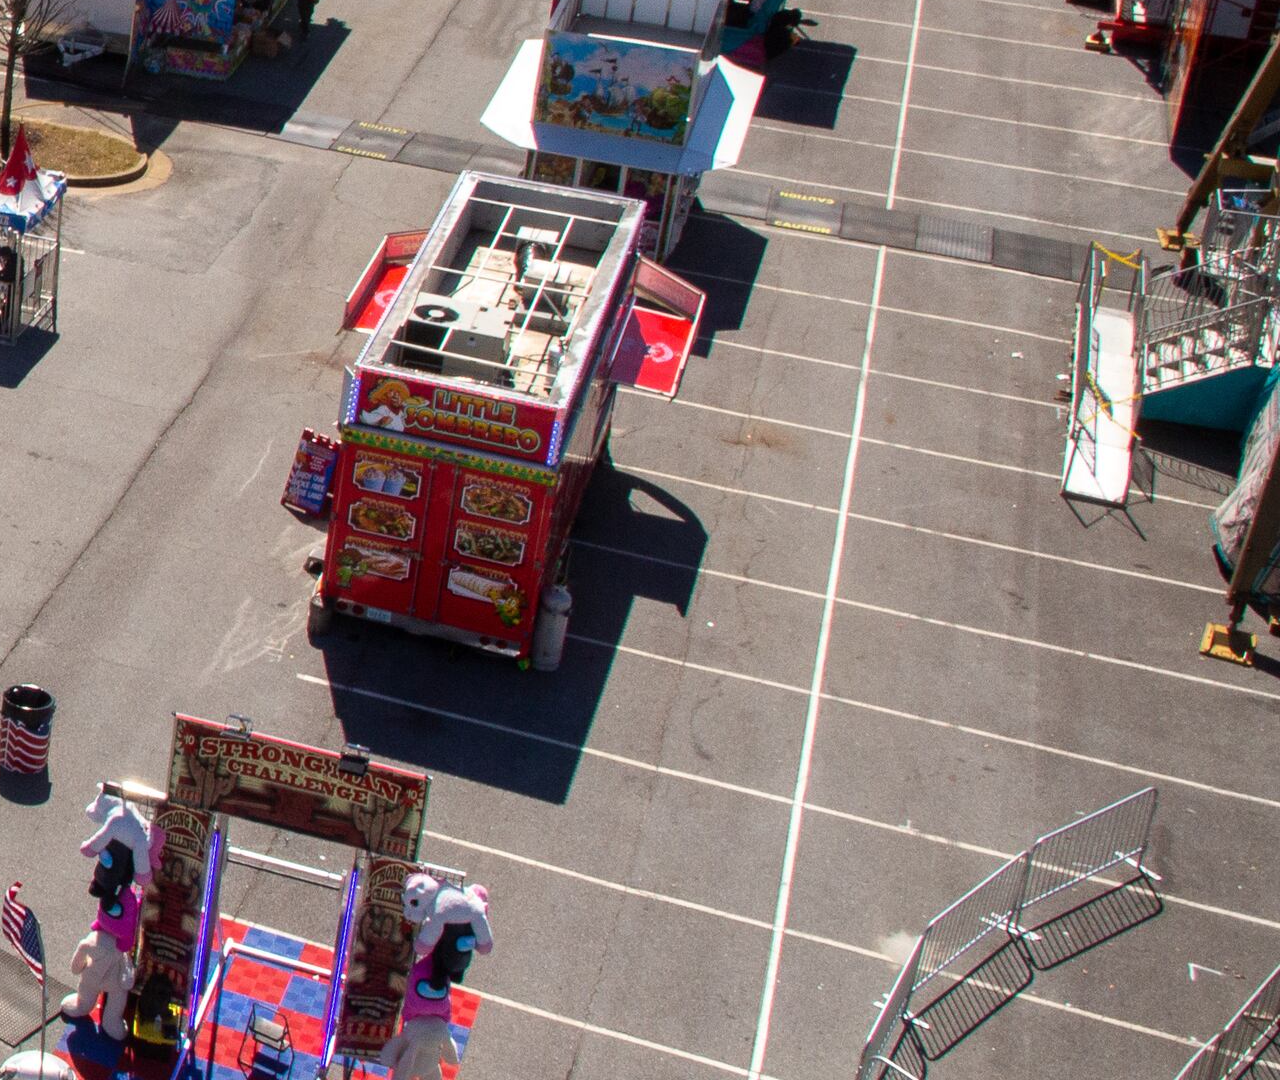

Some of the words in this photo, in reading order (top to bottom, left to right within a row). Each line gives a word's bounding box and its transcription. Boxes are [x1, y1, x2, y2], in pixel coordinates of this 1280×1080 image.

[337, 145, 387, 159] CAUTION
[774, 220, 832, 234] CAUTION
[434, 388, 516, 425] LITTLE
[404, 407, 541, 453] SOMBRERO
[199, 736, 327, 774] STRONG
[226, 758, 370, 806] CHALLENGE
